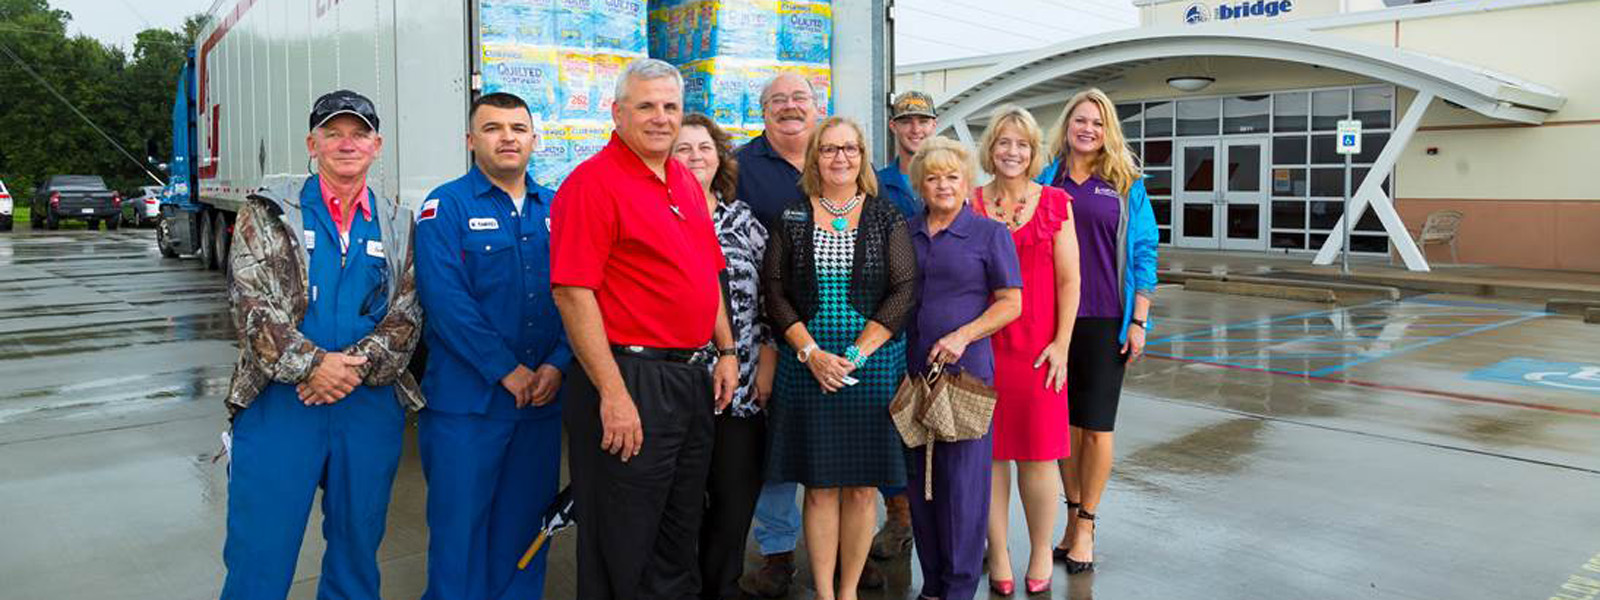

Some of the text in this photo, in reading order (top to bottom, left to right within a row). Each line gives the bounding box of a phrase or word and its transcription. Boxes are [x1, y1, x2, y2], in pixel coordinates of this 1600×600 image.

[1219, 0, 1292, 20] bridge
[497, 62, 542, 78] QUILTED
[571, 94, 588, 105] 262
